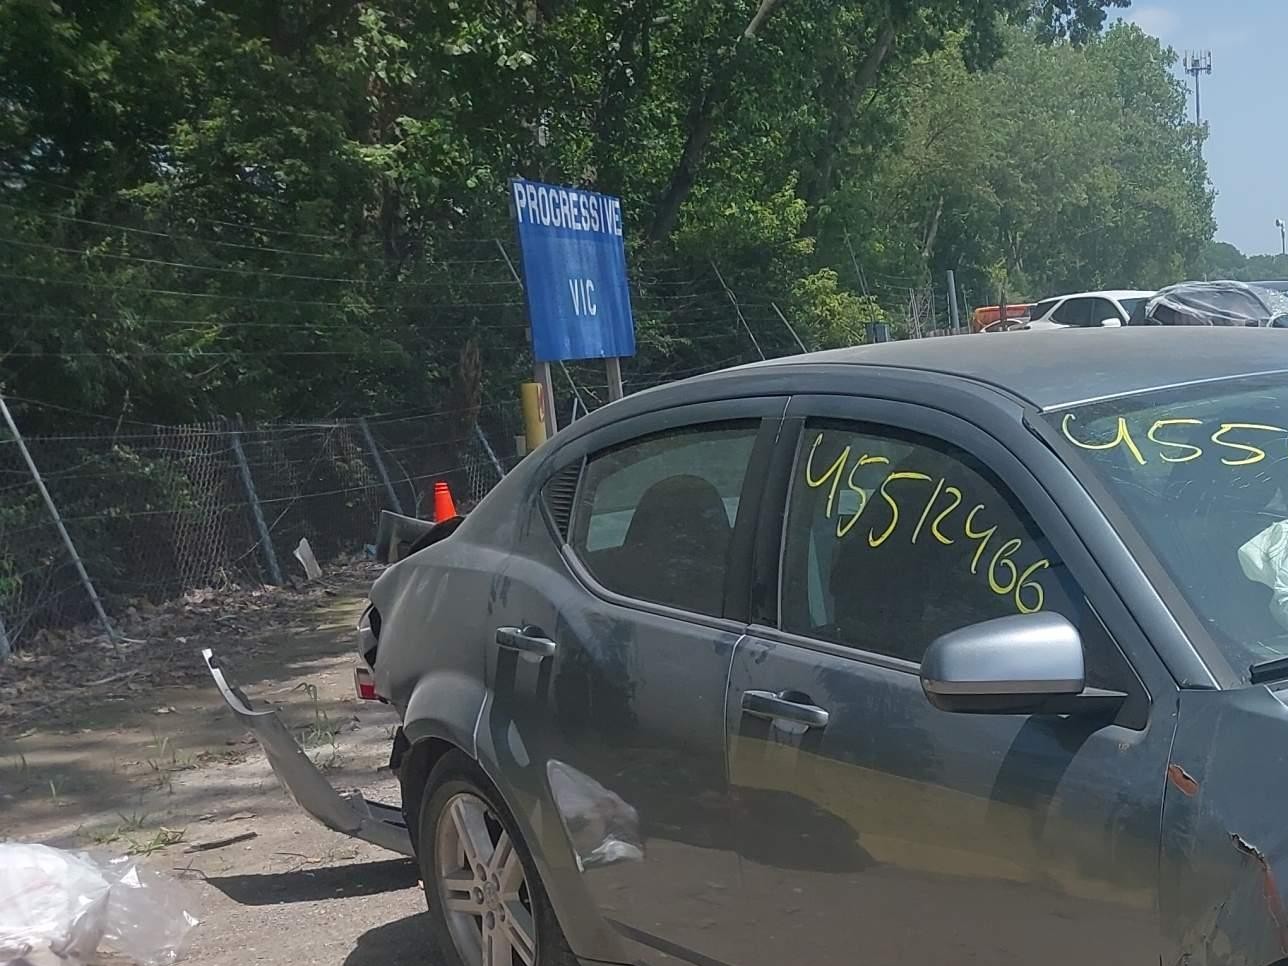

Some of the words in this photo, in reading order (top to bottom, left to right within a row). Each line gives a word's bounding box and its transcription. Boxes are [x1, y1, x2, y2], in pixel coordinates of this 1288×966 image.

[512, 182, 623, 236] PROGRESSIVE
[568, 278, 598, 316] VIC
[806, 432, 1050, 615] 45512466
